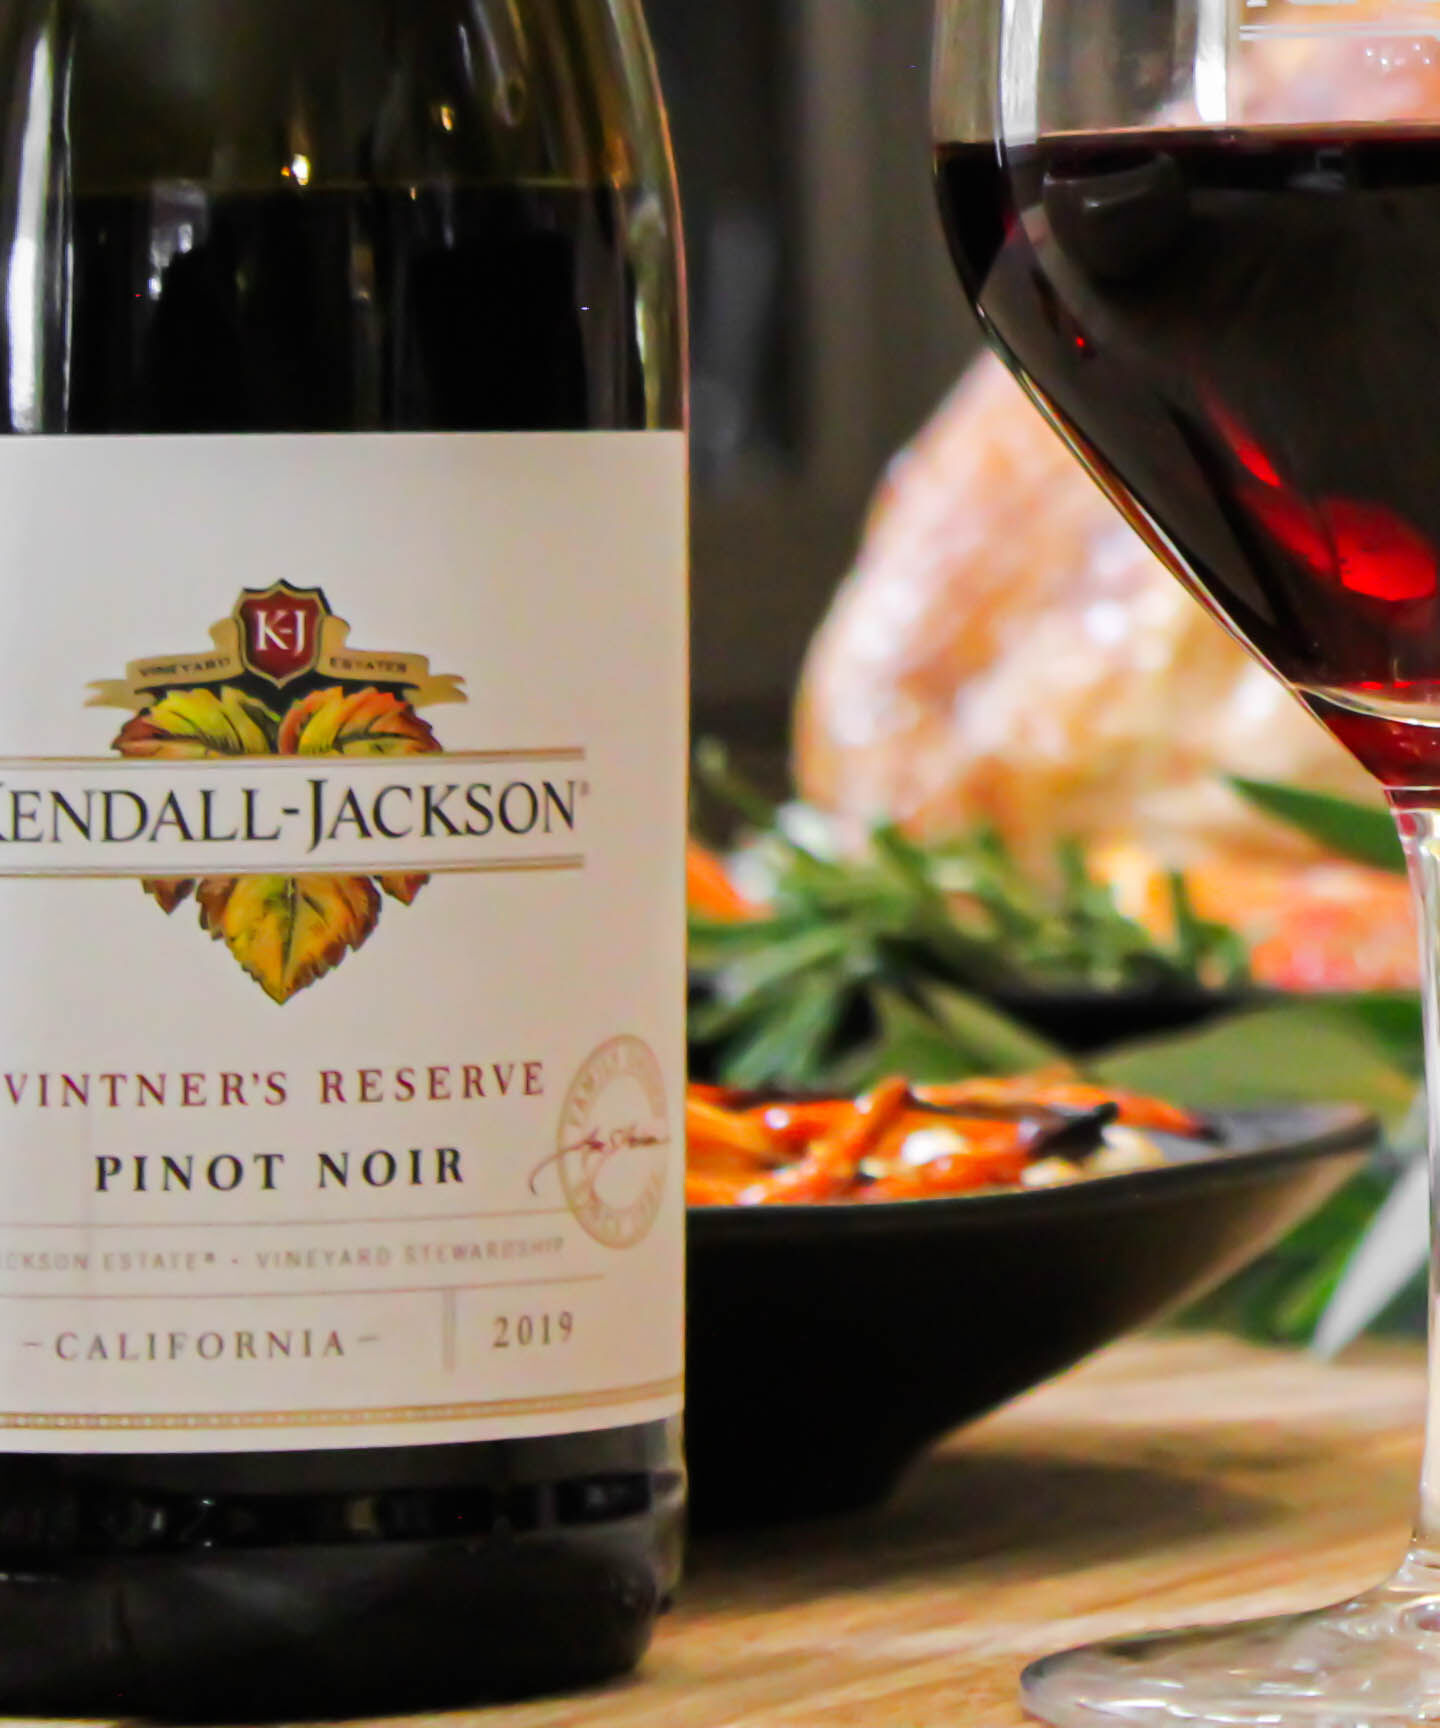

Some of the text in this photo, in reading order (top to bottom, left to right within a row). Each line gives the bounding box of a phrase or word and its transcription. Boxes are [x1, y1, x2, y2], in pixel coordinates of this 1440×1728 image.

[255, 609, 307, 658] K-J
[3, 1060, 545, 1108] VINTNER'S RESERVE
[94, 1146, 464, 1192] PINOT NOIR
[491, 1310, 575, 1349] 2019
